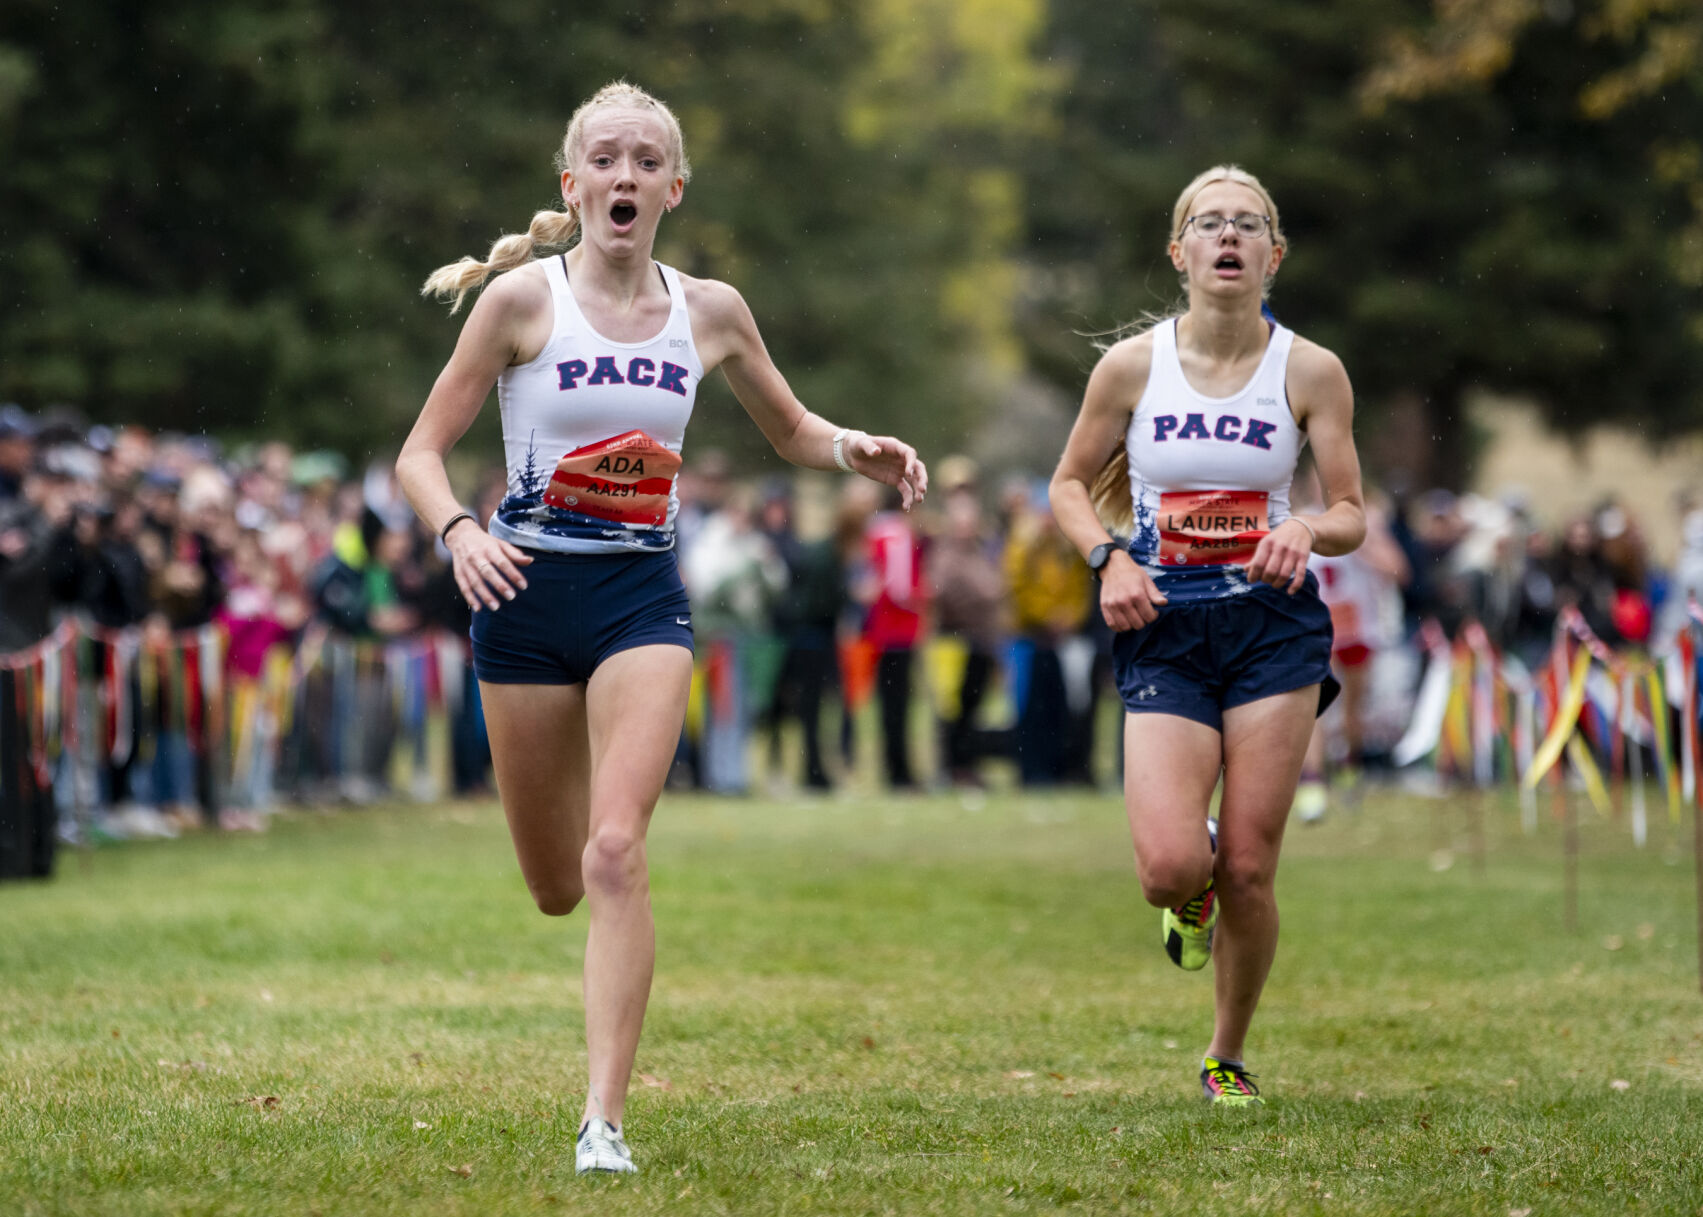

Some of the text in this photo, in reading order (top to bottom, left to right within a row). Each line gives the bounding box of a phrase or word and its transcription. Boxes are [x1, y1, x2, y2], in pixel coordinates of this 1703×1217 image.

[556, 355, 689, 397] PACK
[1153, 413, 1277, 451] PACK
[594, 455, 645, 475] ADA
[586, 482, 638, 497] AA291
[1168, 515, 1258, 532] LAUREN
[1190, 537, 1240, 550] AA286
